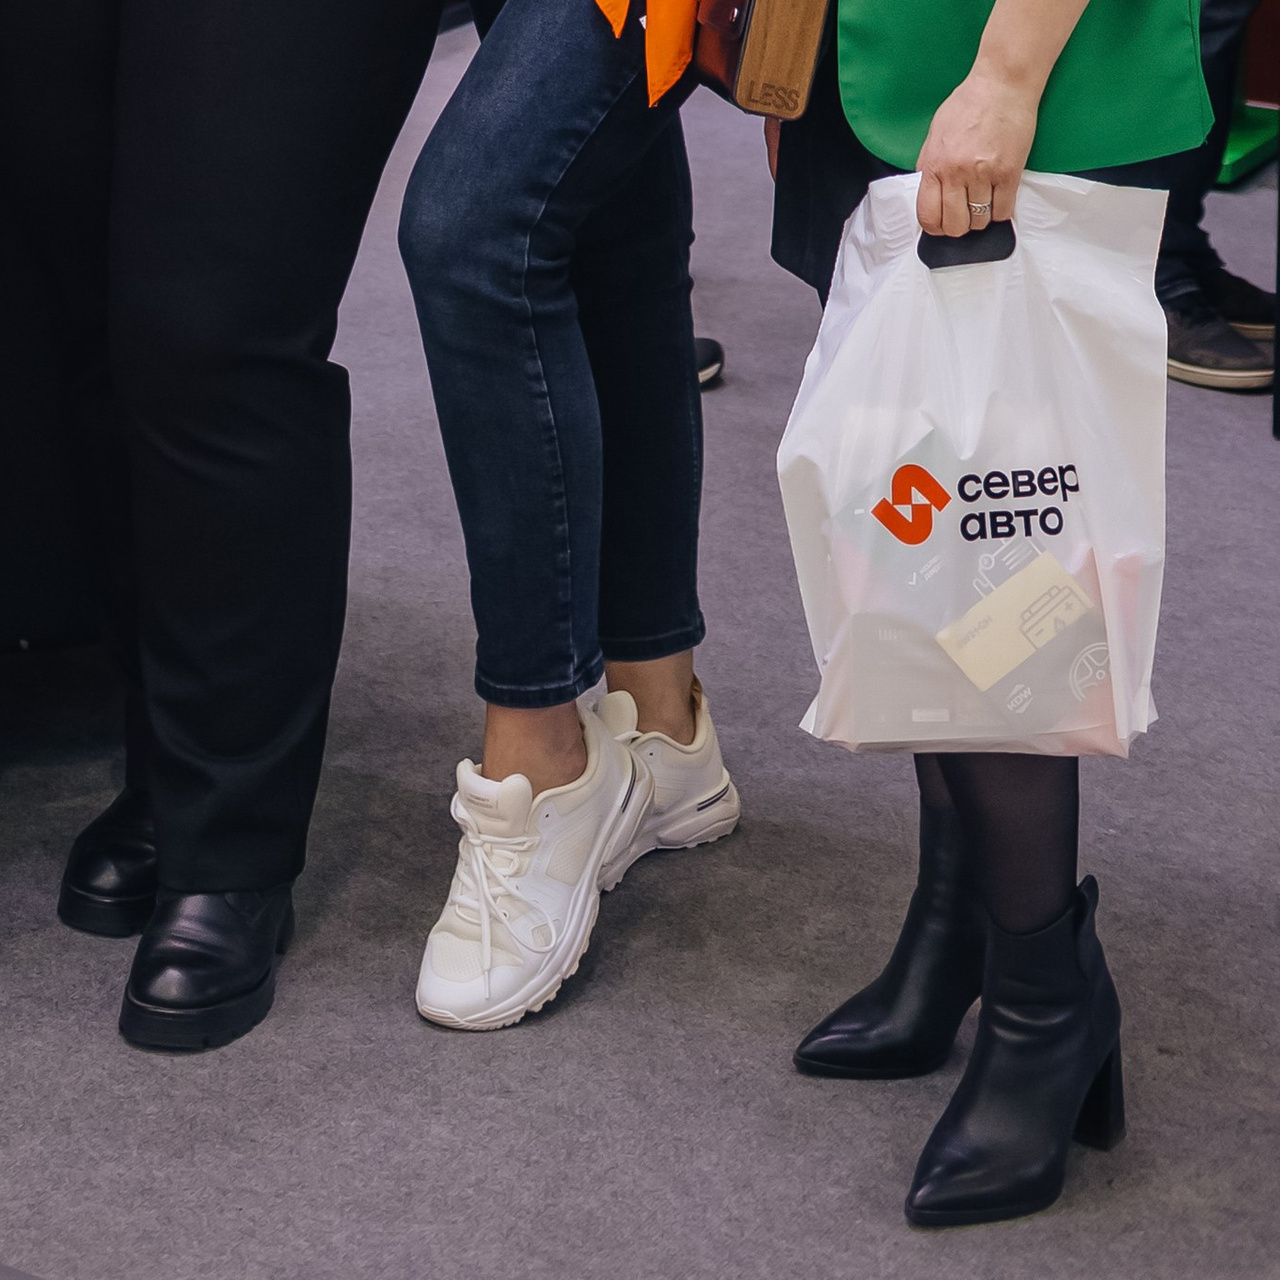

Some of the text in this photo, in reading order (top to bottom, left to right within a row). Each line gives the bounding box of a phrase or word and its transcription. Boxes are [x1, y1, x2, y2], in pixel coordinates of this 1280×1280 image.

[748, 80, 800, 111] LESS
[957, 464, 1079, 502] север
[960, 506, 1064, 541] авто
